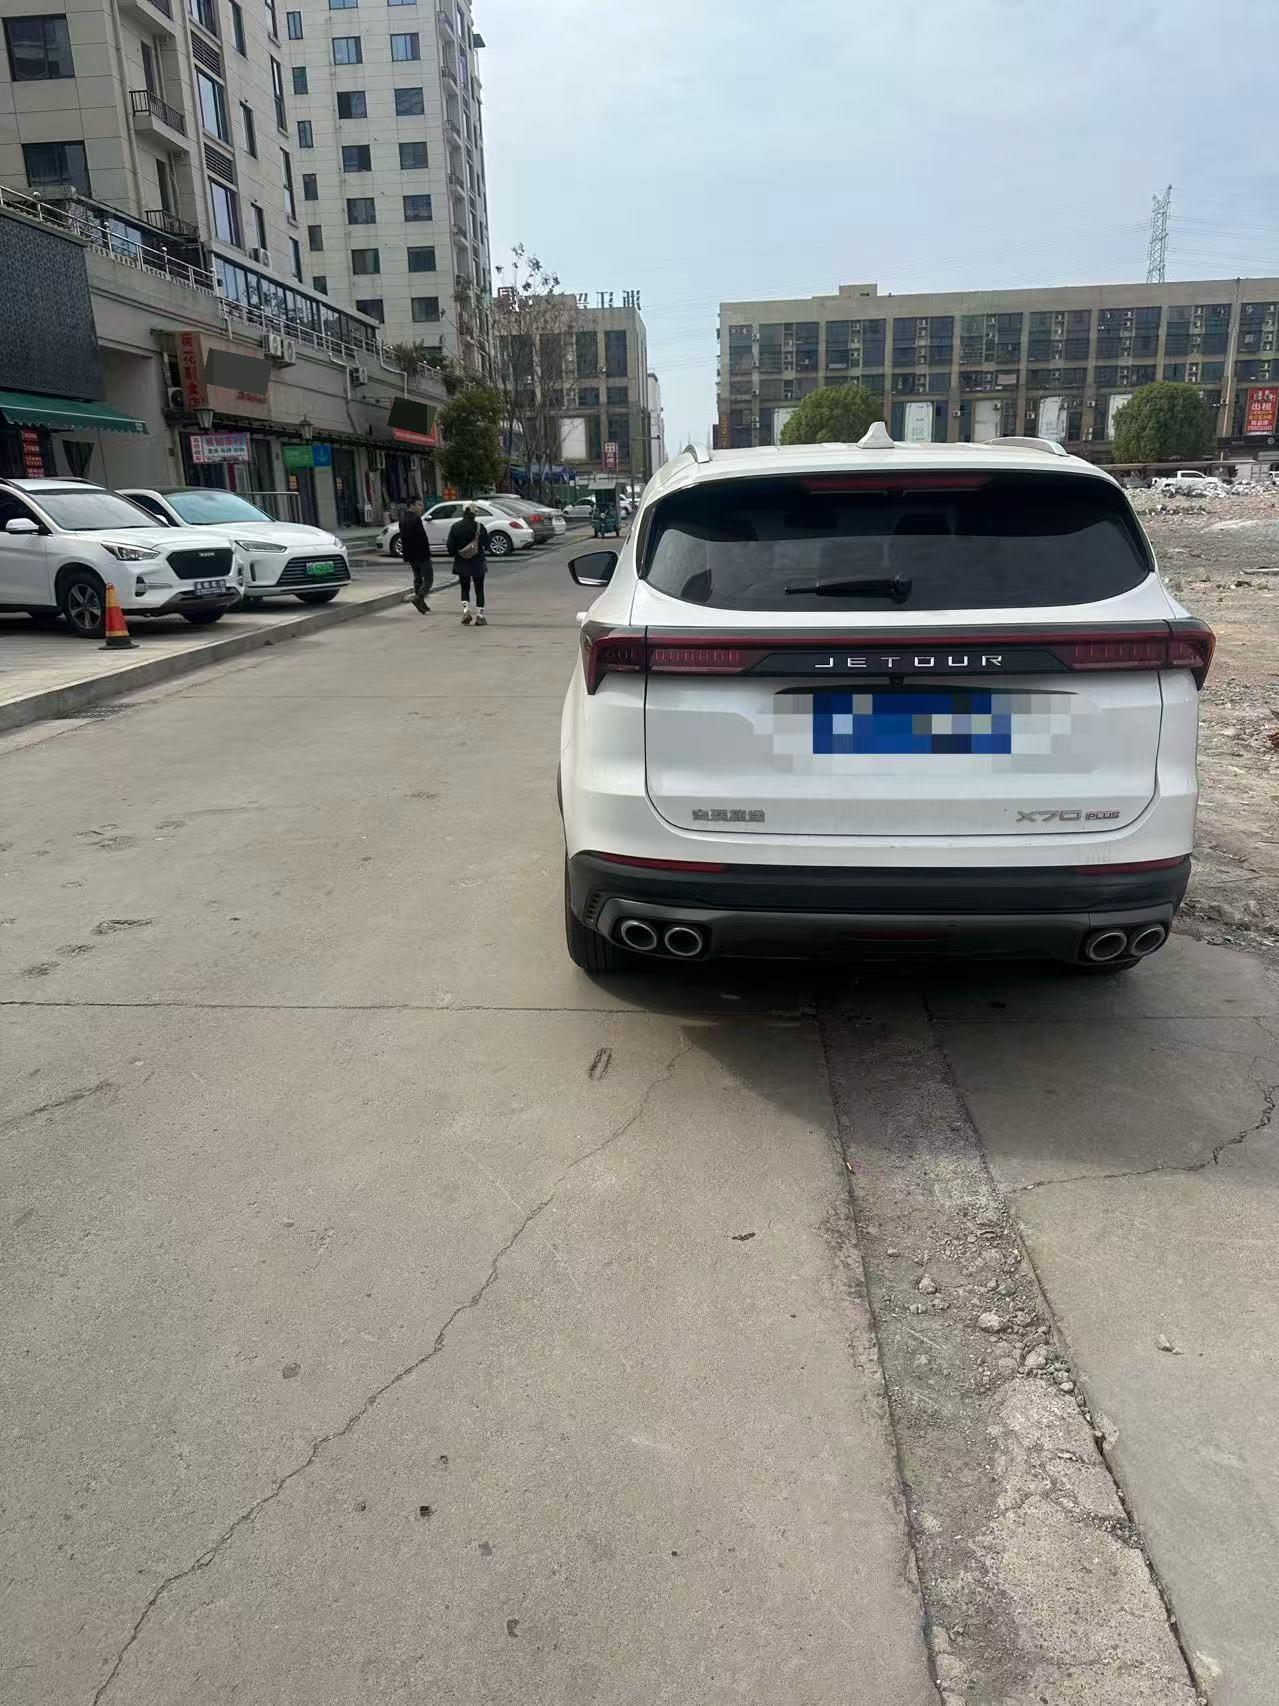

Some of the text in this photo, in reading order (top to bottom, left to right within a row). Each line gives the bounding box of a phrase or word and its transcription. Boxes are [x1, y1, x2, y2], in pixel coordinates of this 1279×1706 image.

[814, 655, 1002, 668] JETOUR
[1016, 809, 1120, 822] X70 PLUS
